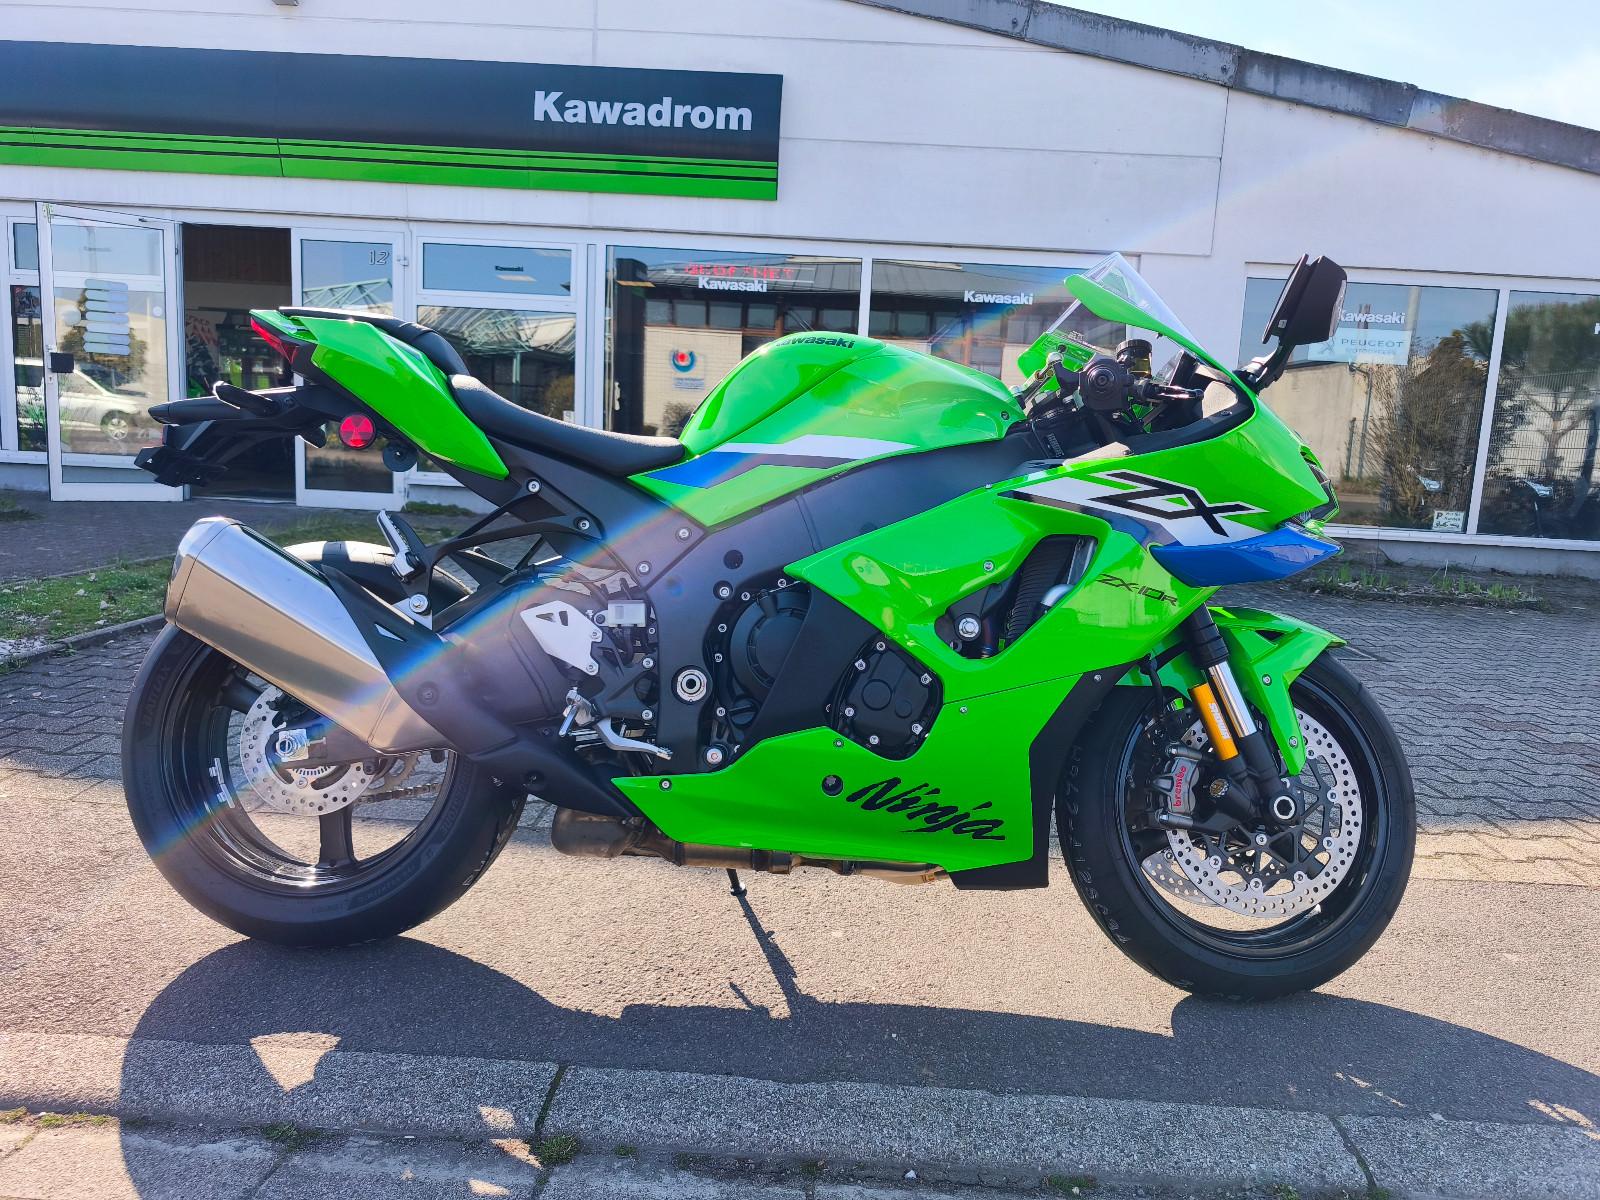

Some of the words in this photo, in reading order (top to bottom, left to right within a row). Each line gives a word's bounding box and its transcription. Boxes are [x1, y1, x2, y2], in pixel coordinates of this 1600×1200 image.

[534, 90, 753, 131] Kawadrom
[369, 249, 390, 265] 12
[698, 276, 768, 292] Kawasaki
[963, 290, 1034, 305] Kawasaki
[776, 336, 855, 348] awasaki
[1341, 338, 1404, 348] PEUGEOT
[1087, 471, 1230, 538] ZX
[1096, 573, 1178, 606] ZX-10R
[1173, 766, 1186, 806] brembo
[846, 777, 1006, 841] Ninja
